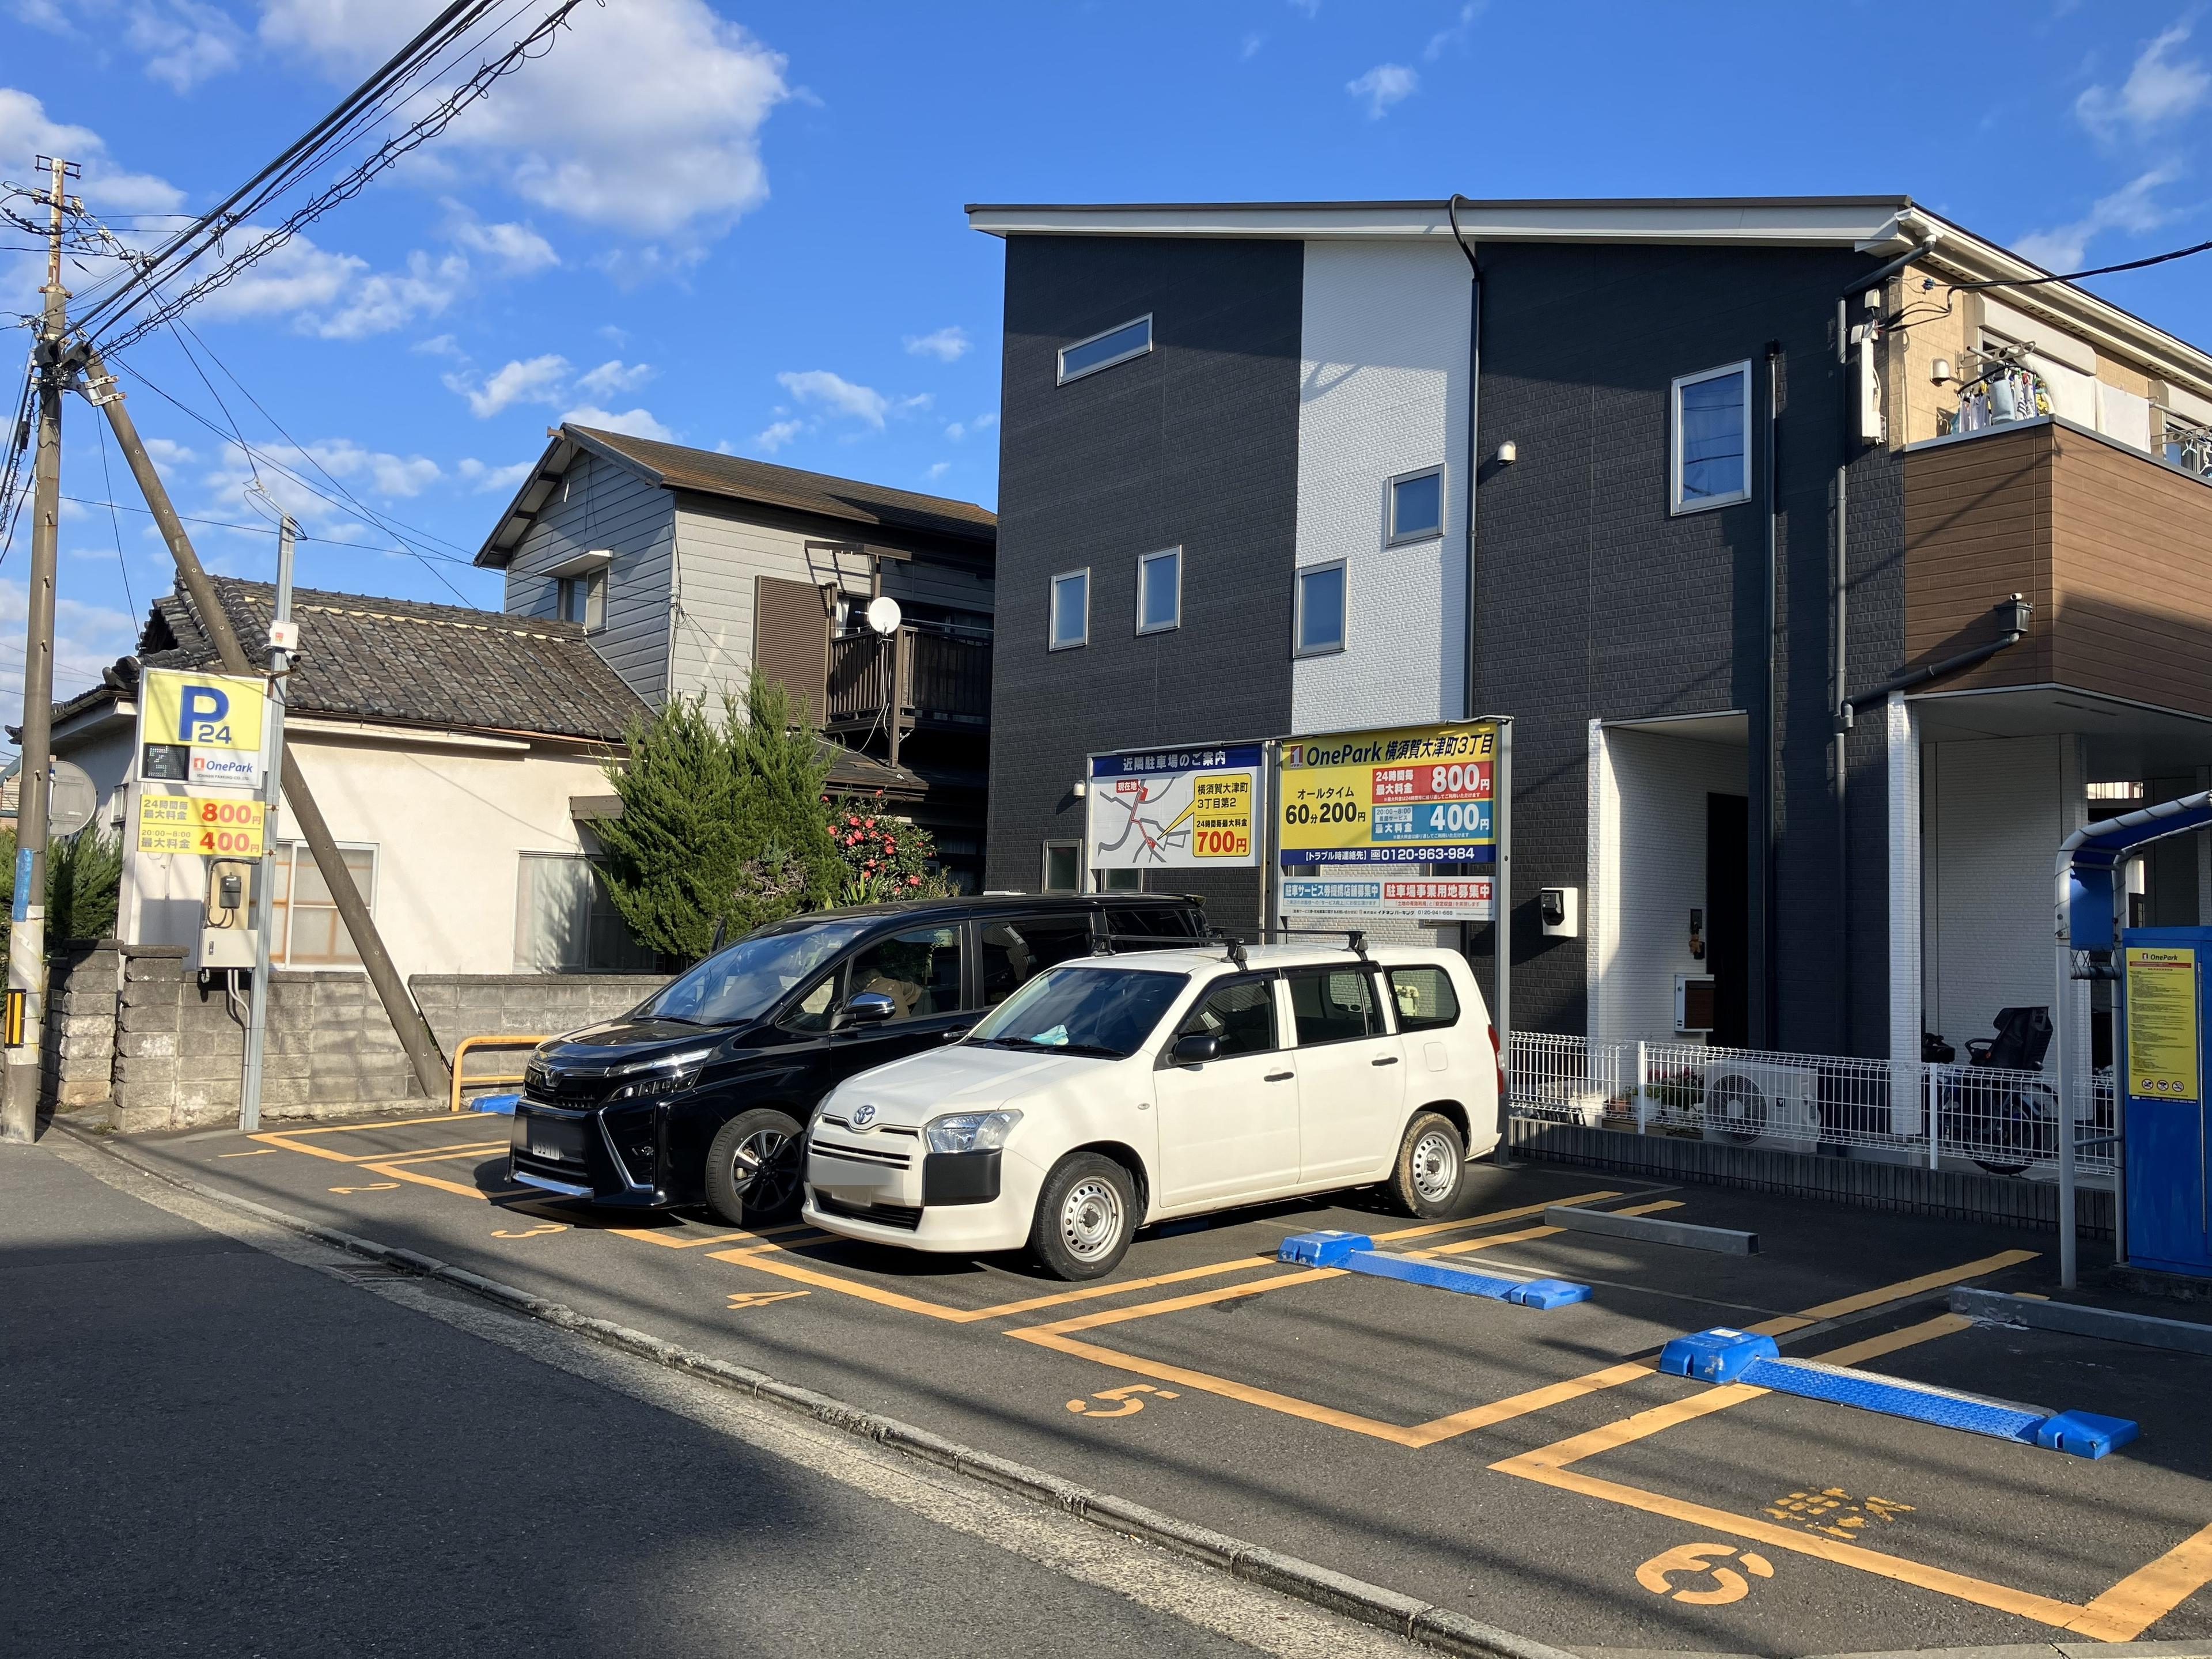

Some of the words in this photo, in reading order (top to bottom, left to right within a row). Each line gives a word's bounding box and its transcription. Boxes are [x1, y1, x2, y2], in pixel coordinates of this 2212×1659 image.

[179, 684, 229, 741] P
[198, 724, 232, 744] 24
[1306, 741, 1382, 766] OnePark
[1385, 733, 1494, 762] 横須賀大津町3丁目
[206, 760, 253, 772] OnePark
[1123, 751, 1226, 771] 近隣駐車場のご案内
[1376, 769, 1414, 782] 24時間毎
[1431, 764, 1490, 793] 800円
[1118, 782, 1137, 791] 現在地
[1197, 782, 1248, 795] 横須賀大津町
[1297, 786, 1354, 800] オールタイム
[1376, 783, 1413, 796] 最大料金
[144, 800, 188, 810] 24時間毎
[1197, 798, 1237, 809] 3丁目第2
[144, 810, 187, 820] 最大料金
[202, 803, 261, 825] 800円
[1286, 801, 1366, 824] 60分200円
[1430, 803, 1490, 831] 400円
[1196, 818, 1248, 827] 24時間毎最大料金
[1375, 823, 1412, 834] 最大料金
[141, 838, 191, 849] 最大料金
[199, 832, 259, 853] 400円
[1197, 830, 1247, 853] 700円
[1381, 847, 1475, 860] 0120-963-984
[1386, 884, 1490, 898] 駐車場事業用地募集中
[327, 1182, 401, 1194] 2
[490, 1225, 568, 1238] 3
[726, 1290, 812, 1310] 4
[1066, 1383, 1180, 1418] 5
[1634, 1543, 1775, 1605] 6
